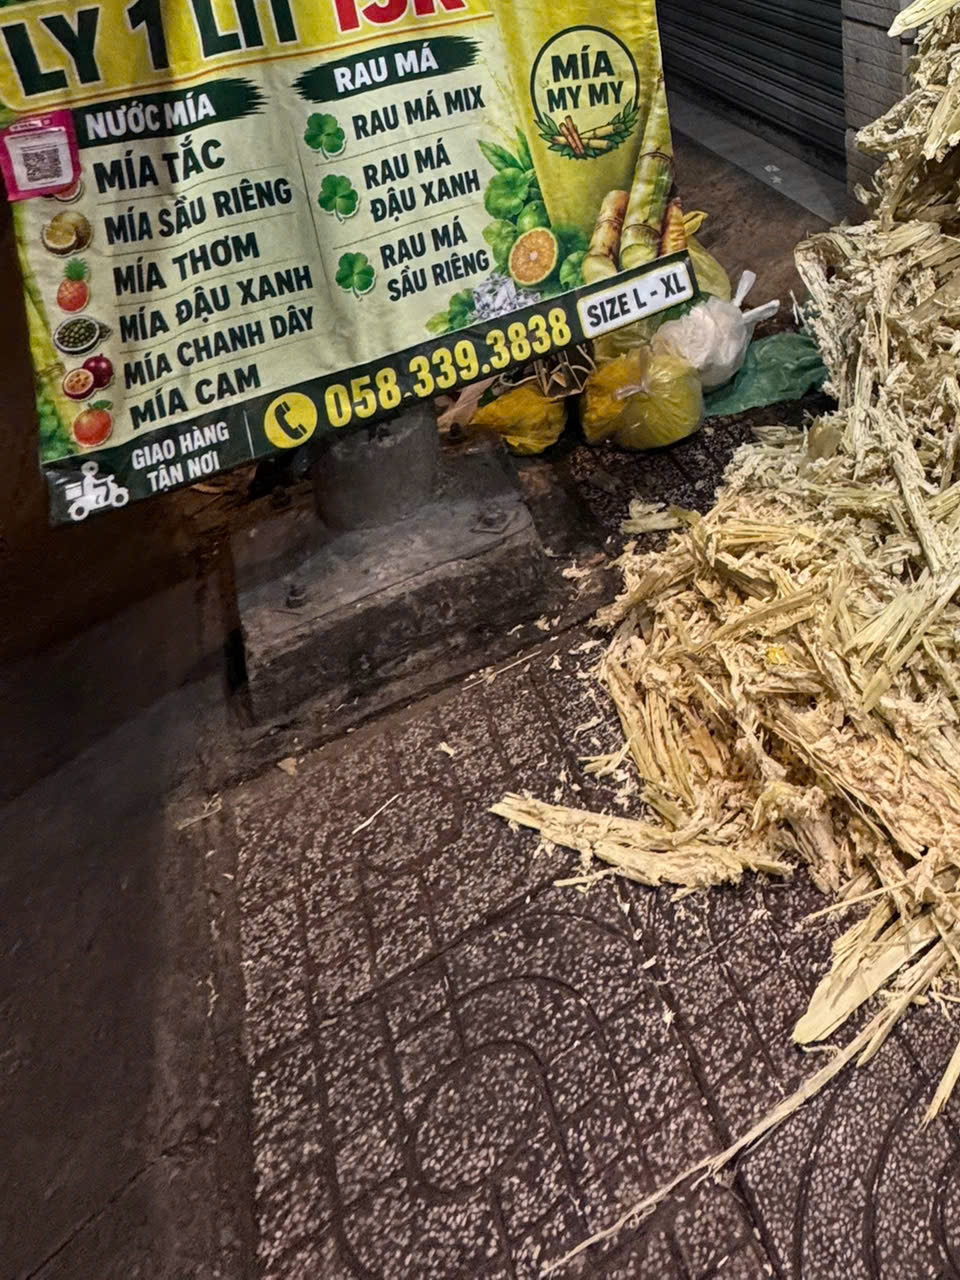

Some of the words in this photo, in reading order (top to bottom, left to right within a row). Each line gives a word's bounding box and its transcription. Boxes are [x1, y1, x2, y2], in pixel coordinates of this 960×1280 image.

[2, 6, 101, 96] LY
[333, 57, 388, 93] RAU
[394, 42, 439, 77] MÁ
[551, 45, 615, 83] MÍA
[85, 100, 161, 141] NƯỚC
[164, 92, 217, 129] MÍA
[352, 104, 399, 140] RAU
[403, 89, 441, 125] MÁ
[444, 85, 486, 115] MIX
[546, 85, 582, 113] MY
[588, 81, 624, 107] MY
[93, 149, 159, 194] MÍA
[162, 134, 225, 184] TẮC
[363, 153, 409, 190] RAU
[414, 137, 451, 173] MÁ
[104, 207, 153, 245] MÍA
[158, 194, 206, 238] SẦU
[213, 177, 292, 218] RIÊNG
[370, 187, 416, 222] ĐẬU
[420, 169, 481, 207] XANH
[113, 256, 167, 296] MÍA
[172, 232, 260, 281] THƠM
[380, 232, 426, 269] RAU
[431, 215, 468, 251] MÁ
[387, 265, 427, 301] SẦU
[431, 249, 490, 286] RIÊNG
[586, 294, 628, 329] SIZE
[631, 289, 647, 314] L
[660, 275, 686, 302] XL
[119, 306, 169, 343] MÍA
[175, 285, 231, 326] ĐẬU
[236, 265, 313, 305] XANH
[123, 351, 172, 389] MÍA
[177, 320, 265, 367] CHANH
[270, 305, 314, 339] DÂY
[326, 307, 571, 428] 058.339.3838
[129, 387, 188, 430] MÍA
[195, 363, 261, 405] CAM
[131, 437, 176, 470] GIAO
[179, 419, 229, 457] HÀNG
[147, 460, 182, 494] TẬN
[185, 453, 220, 486] NƠI
